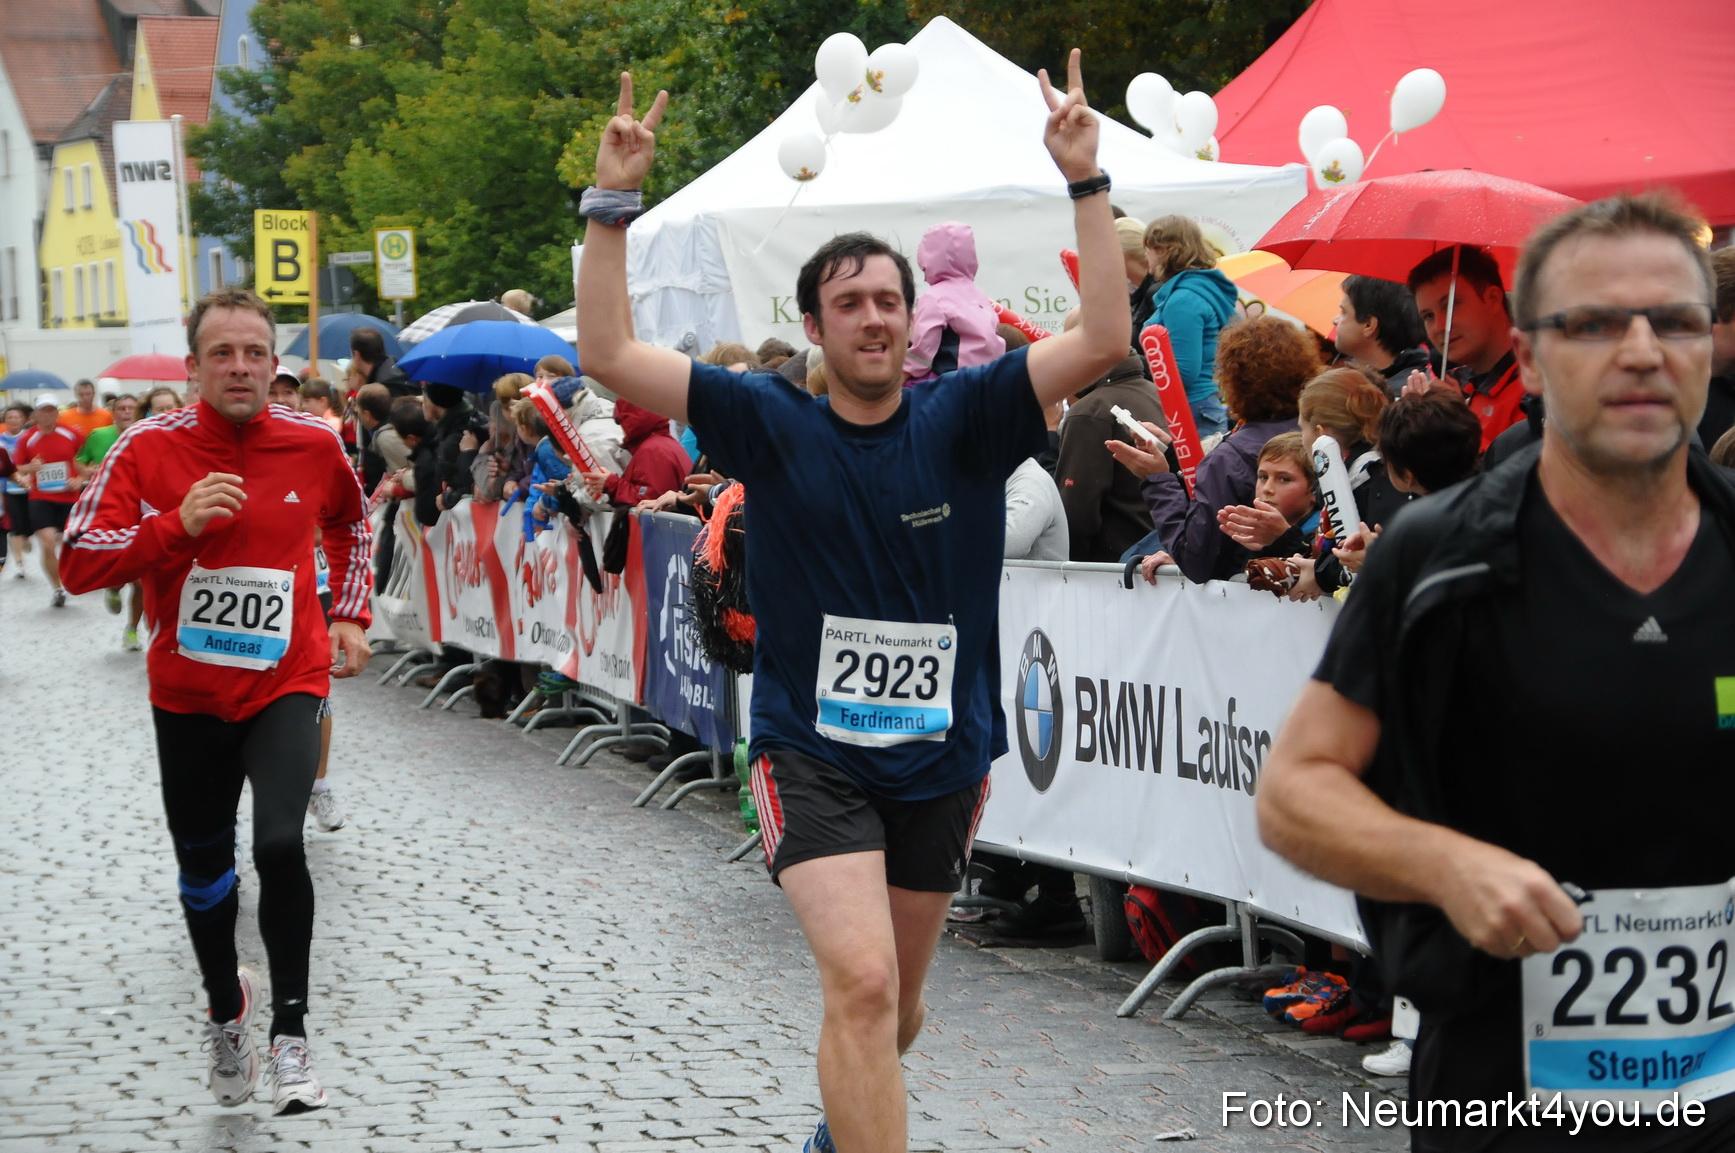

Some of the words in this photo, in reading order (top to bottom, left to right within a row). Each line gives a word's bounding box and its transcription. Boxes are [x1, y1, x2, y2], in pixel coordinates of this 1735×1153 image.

[262, 214, 309, 231] Block
[272, 238, 302, 282] B
[1013, 316, 1046, 339] BKK
[553, 406, 597, 470] AUSTRIA
[1164, 411, 1191, 460] BKK
[38, 468, 64, 481] 3109
[188, 574, 223, 586] PARTL
[225, 576, 278, 589] Neumarkt
[191, 588, 284, 632] 2202
[204, 634, 262, 655] Andreas
[825, 628, 871, 644] PARTL
[875, 634, 932, 648] Neumarkt
[832, 648, 940, 701] 2923
[840, 707, 926, 730] Ferdinand
[1075, 675, 1165, 774] BMW
[1616, 911, 1722, 933] Neumarkt
[1551, 939, 1735, 1027] 2232
[1535, 1024, 1544, 1037] B
